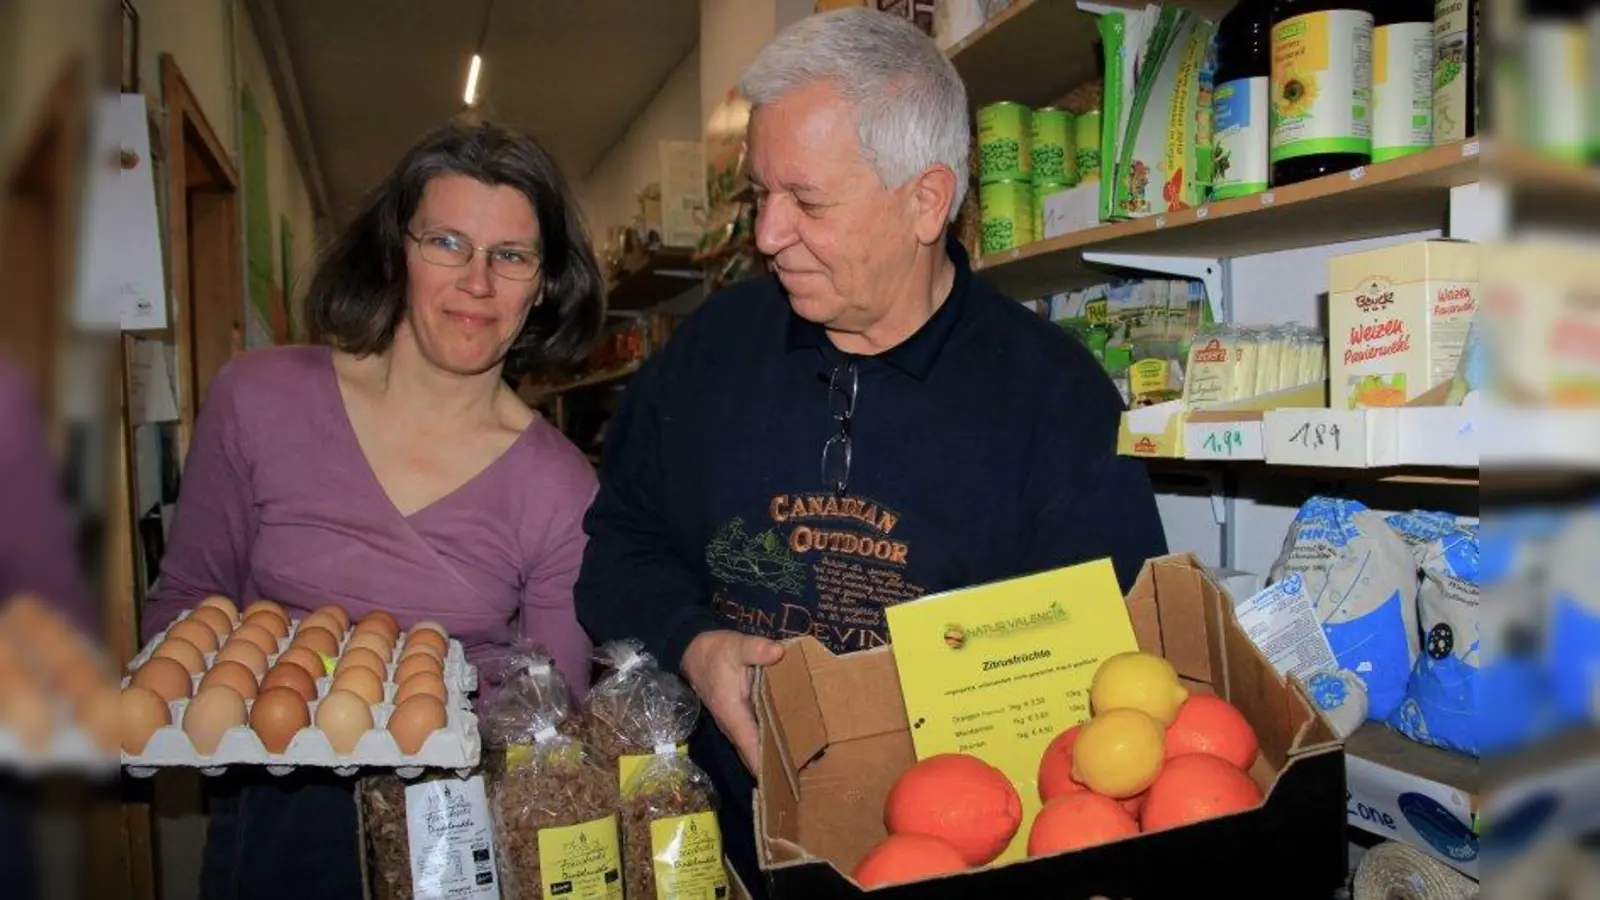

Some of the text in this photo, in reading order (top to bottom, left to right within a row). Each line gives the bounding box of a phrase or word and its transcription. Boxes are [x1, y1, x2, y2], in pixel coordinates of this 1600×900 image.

[1350, 318, 1404, 346] Weizen
[1344, 334, 1411, 366] Paniermehl
[769, 494, 898, 534] CANADIAN
[789, 526, 909, 565] OUTDOOR
[981, 649, 1052, 672] Zitrusfrüchte
